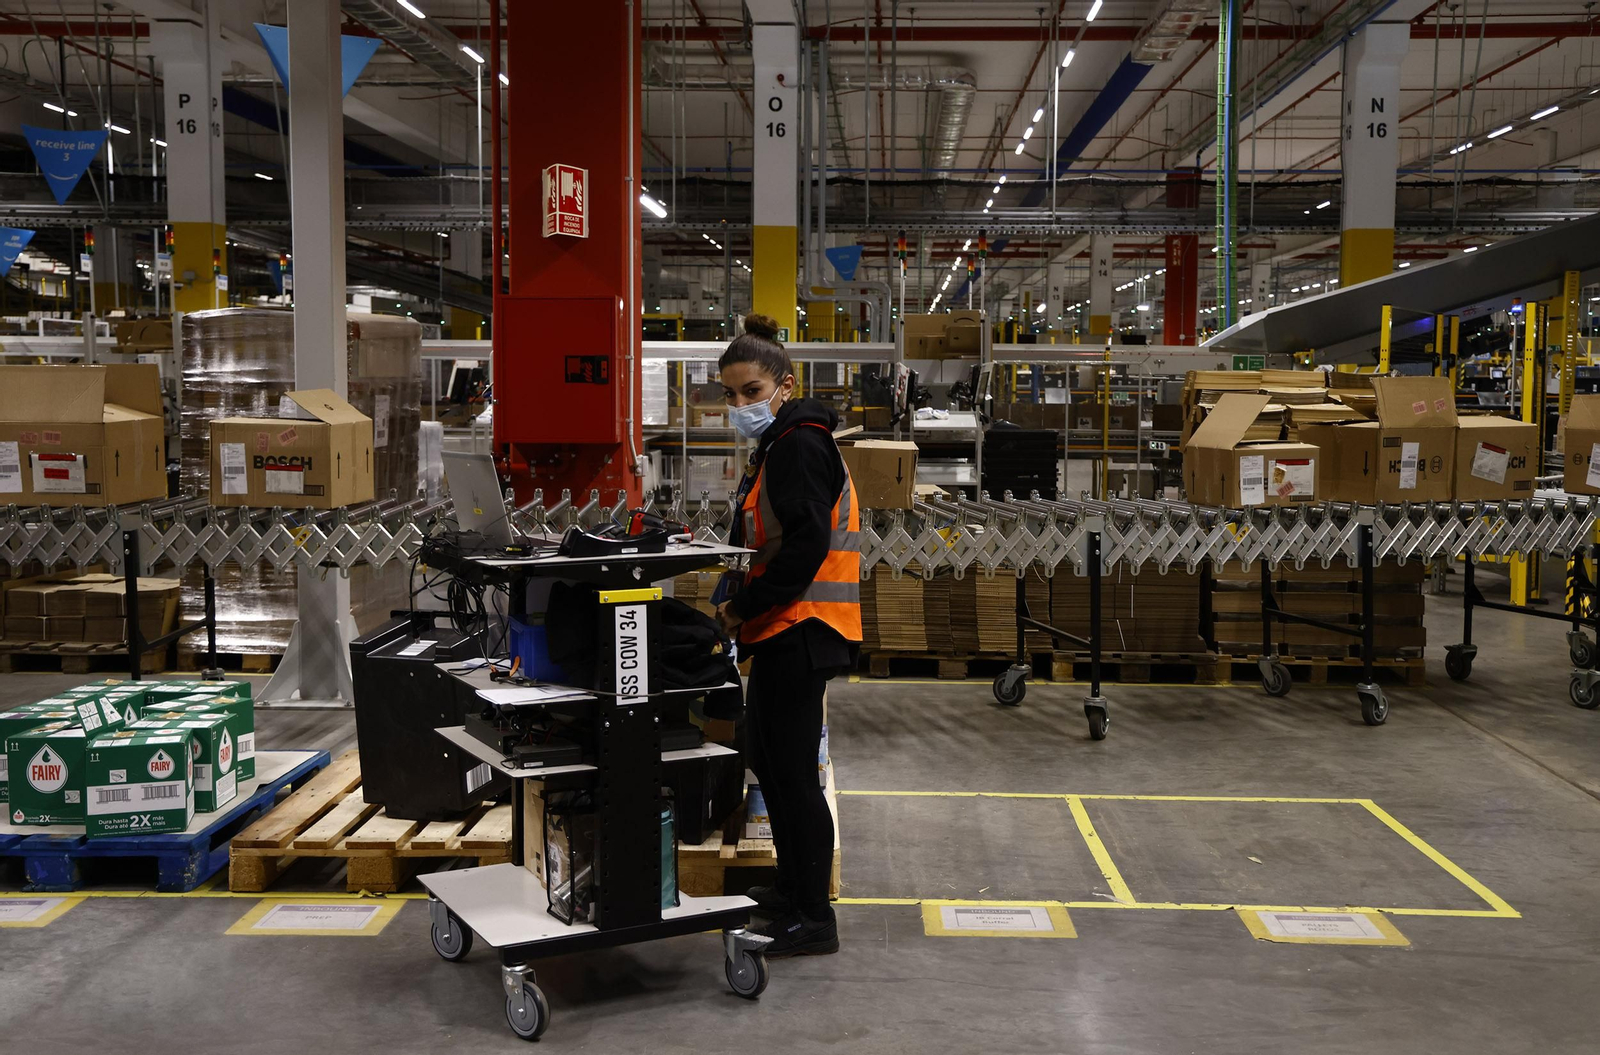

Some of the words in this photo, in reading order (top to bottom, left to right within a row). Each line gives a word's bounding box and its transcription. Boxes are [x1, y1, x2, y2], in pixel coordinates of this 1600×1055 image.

[179, 94, 191, 108] P
[769, 96, 782, 112] O
[1371, 97, 1384, 113] N
[177, 119, 196, 134] 16
[766, 122, 786, 137] 16
[1367, 122, 1387, 138] 16
[36, 139, 75, 150] receive
[78, 141, 96, 150] line
[63, 152, 70, 161] 3
[253, 455, 312, 470] BOSCH
[619, 610, 637, 630] 34
[620, 636, 638, 670] COW
[621, 675, 639, 700] ISS
[32, 765, 61, 780] FAIRY
[150, 761, 171, 772] FAIRY
[40, 814, 50, 823] 2X
[130, 814, 151, 828] 2X
